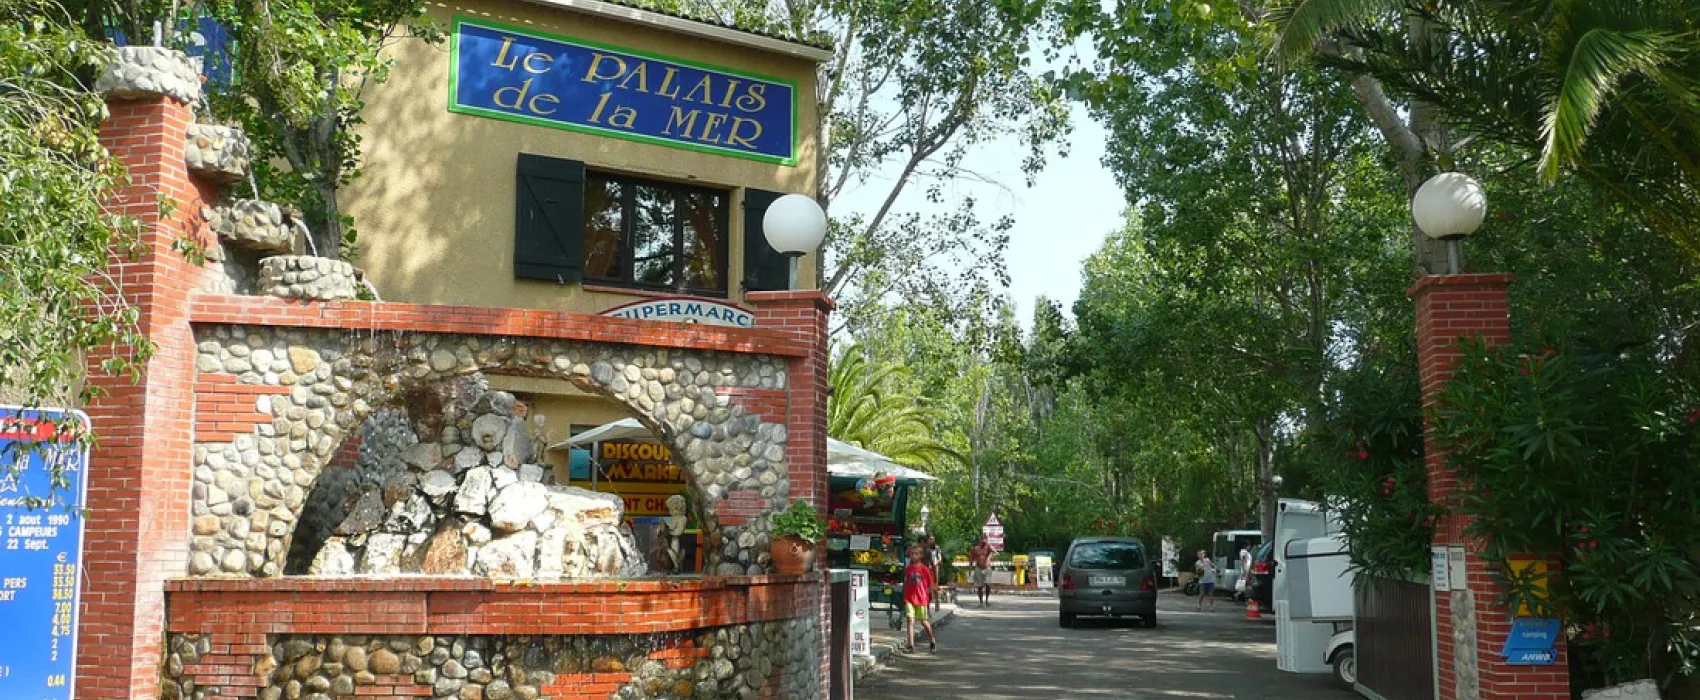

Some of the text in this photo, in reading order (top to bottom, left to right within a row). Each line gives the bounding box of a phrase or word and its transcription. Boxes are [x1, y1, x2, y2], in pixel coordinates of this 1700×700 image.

[491, 36, 767, 113] Le PALAIS
[493, 78, 764, 149] de la MER
[612, 302, 754, 327] UPERMARC
[607, 463, 686, 480] MARKE
[8, 525, 58, 538] CAMPEURS
[6, 539, 19, 550] 22
[4, 577, 27, 589] PERS
[1521, 653, 1551, 662] ANWB
